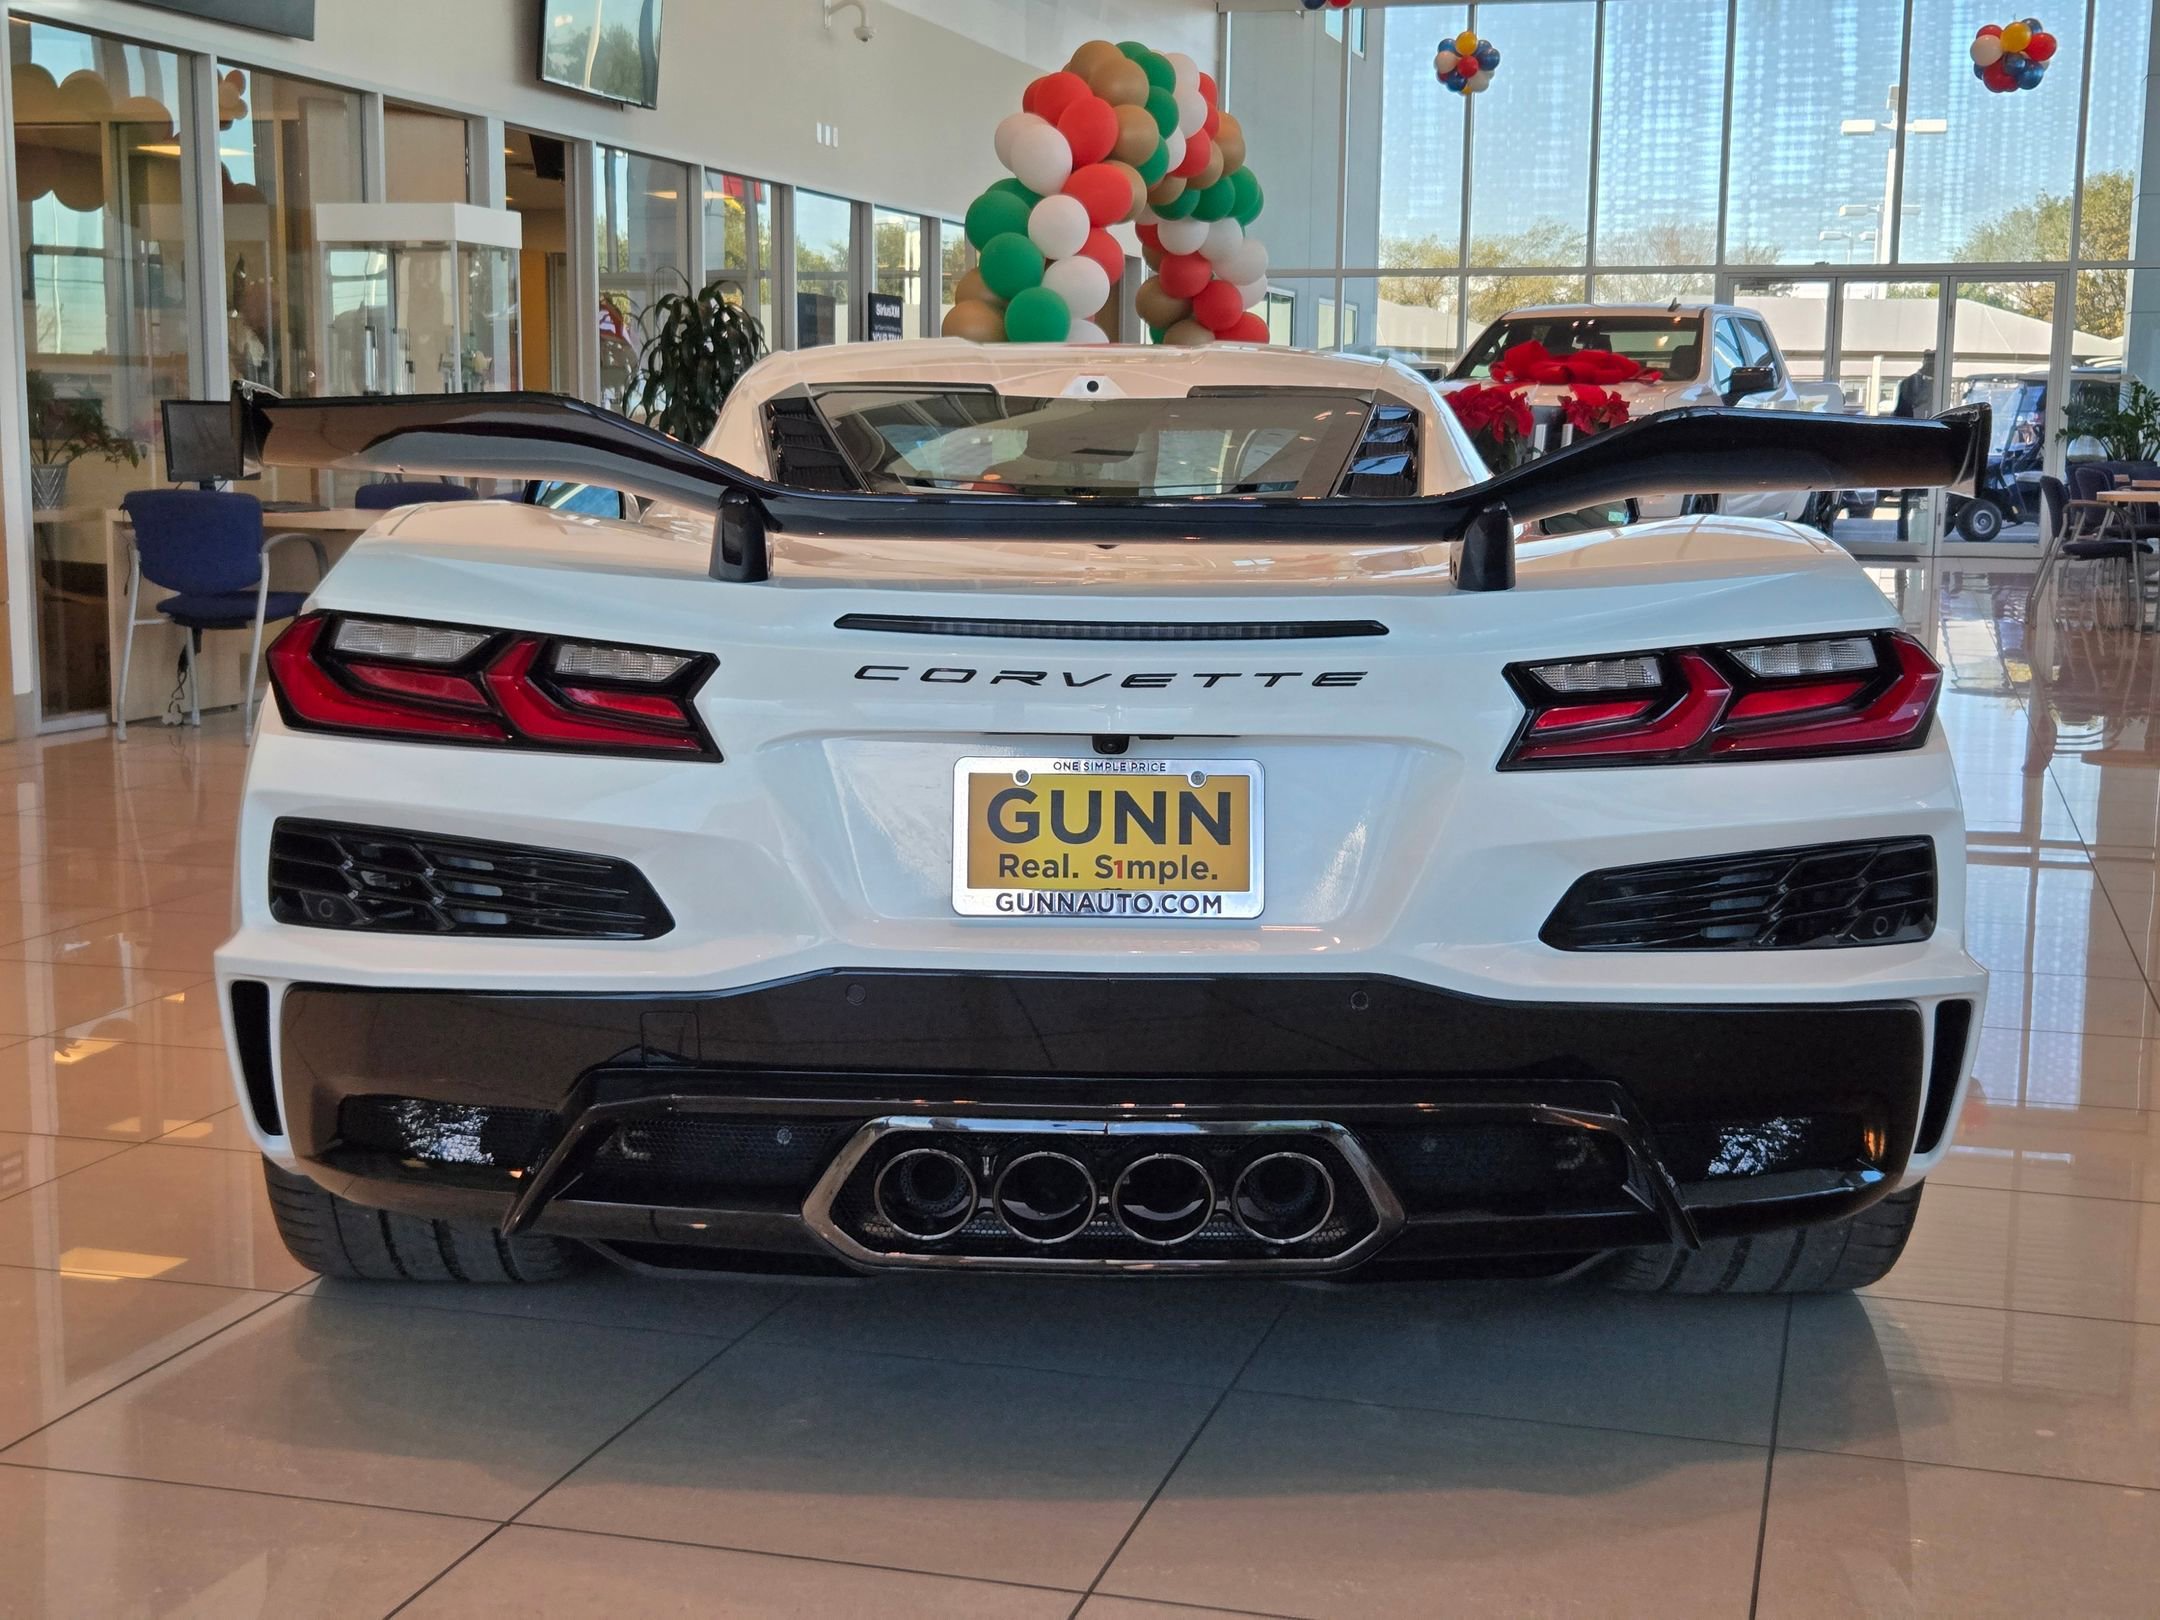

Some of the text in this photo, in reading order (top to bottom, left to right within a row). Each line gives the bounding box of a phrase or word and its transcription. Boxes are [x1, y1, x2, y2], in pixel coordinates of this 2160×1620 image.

[854, 665, 1368, 688] CORVETTE
[1053, 761, 1167, 772] ONE SIMPLE PRICE
[987, 787, 1231, 846] GUNN
[999, 853, 1079, 880] Real.
[996, 892, 1222, 915] GUNNAUTO.COM
